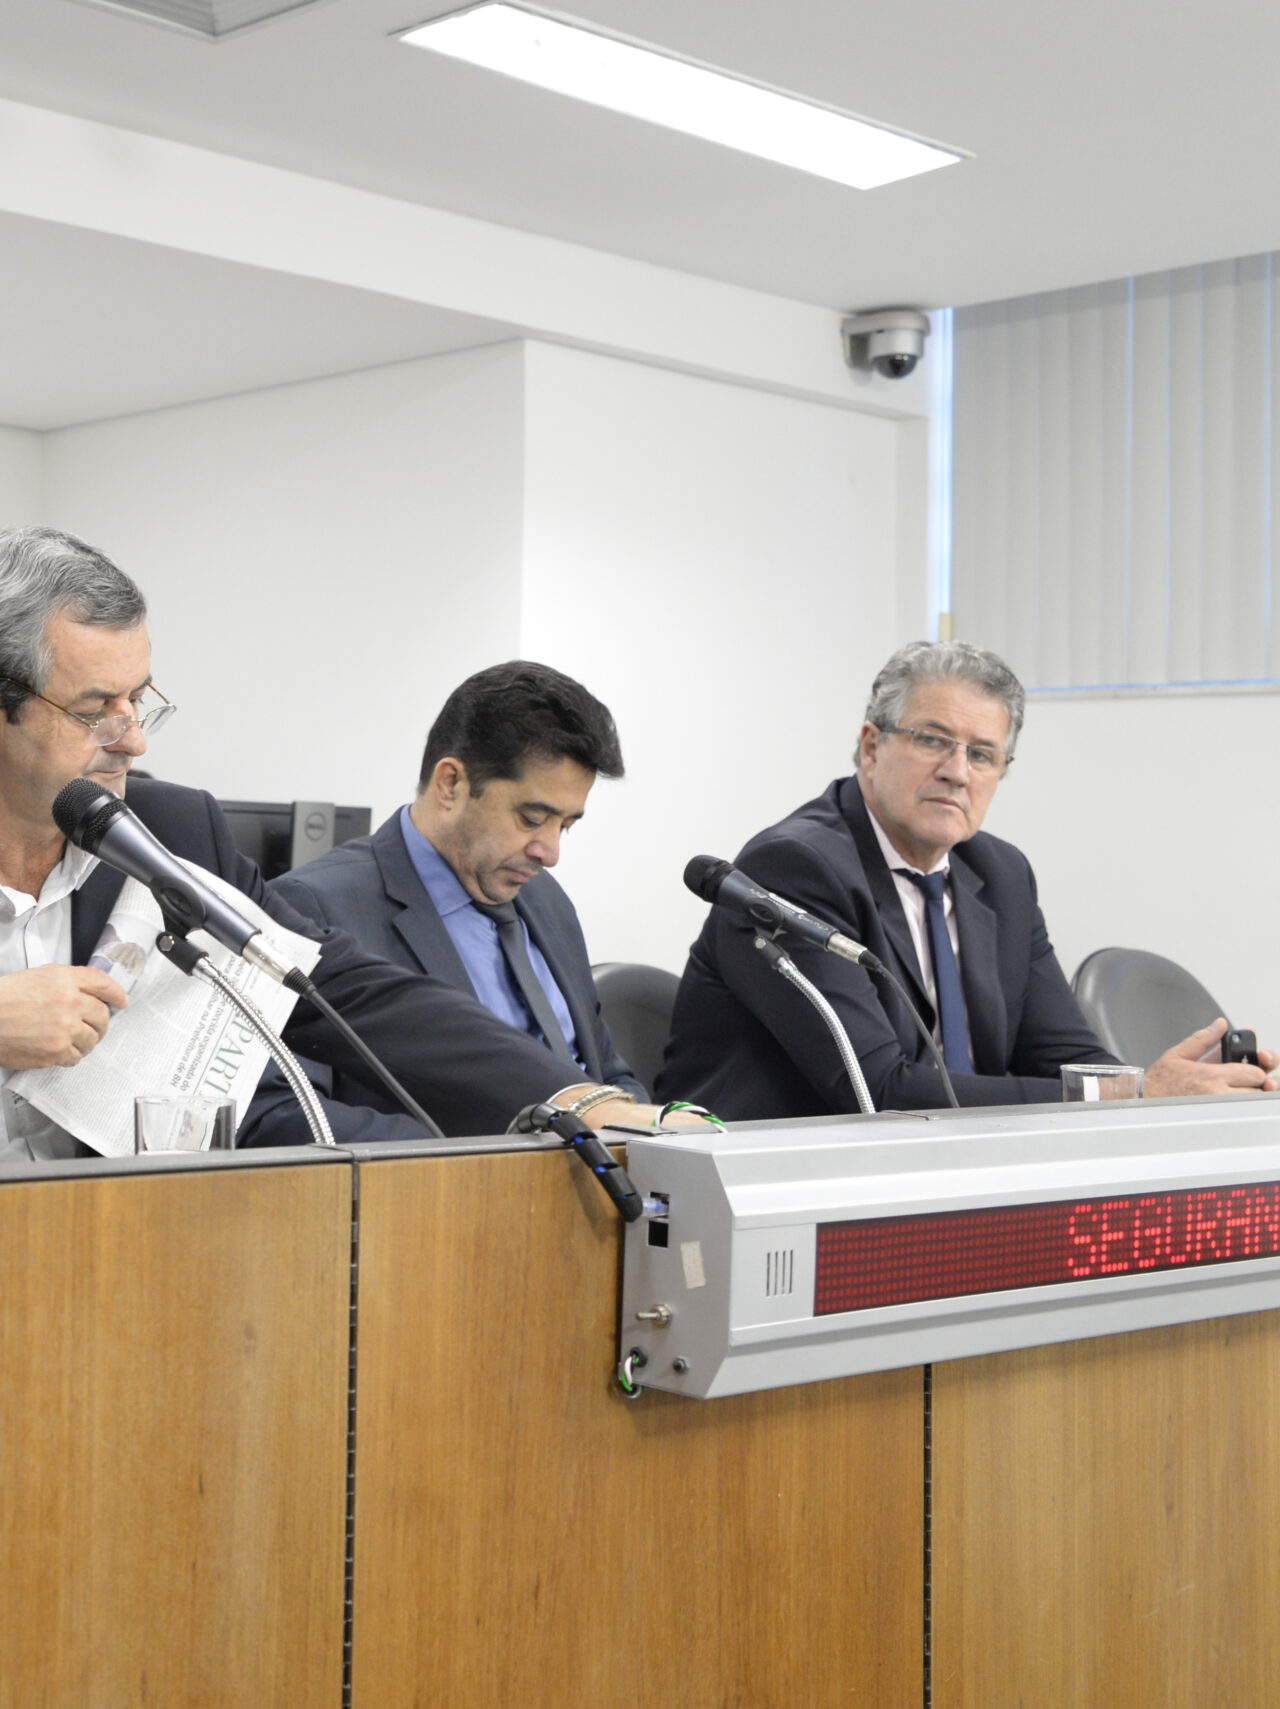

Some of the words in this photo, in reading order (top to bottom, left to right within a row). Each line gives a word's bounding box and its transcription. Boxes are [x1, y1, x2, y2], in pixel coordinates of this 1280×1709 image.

[181, 1022, 205, 1062] Prefeitura
[183, 1034, 210, 1081] organizada
[203, 1015, 255, 1096] PART
[1067, 1185, 1280, 1278] SEGURAN
